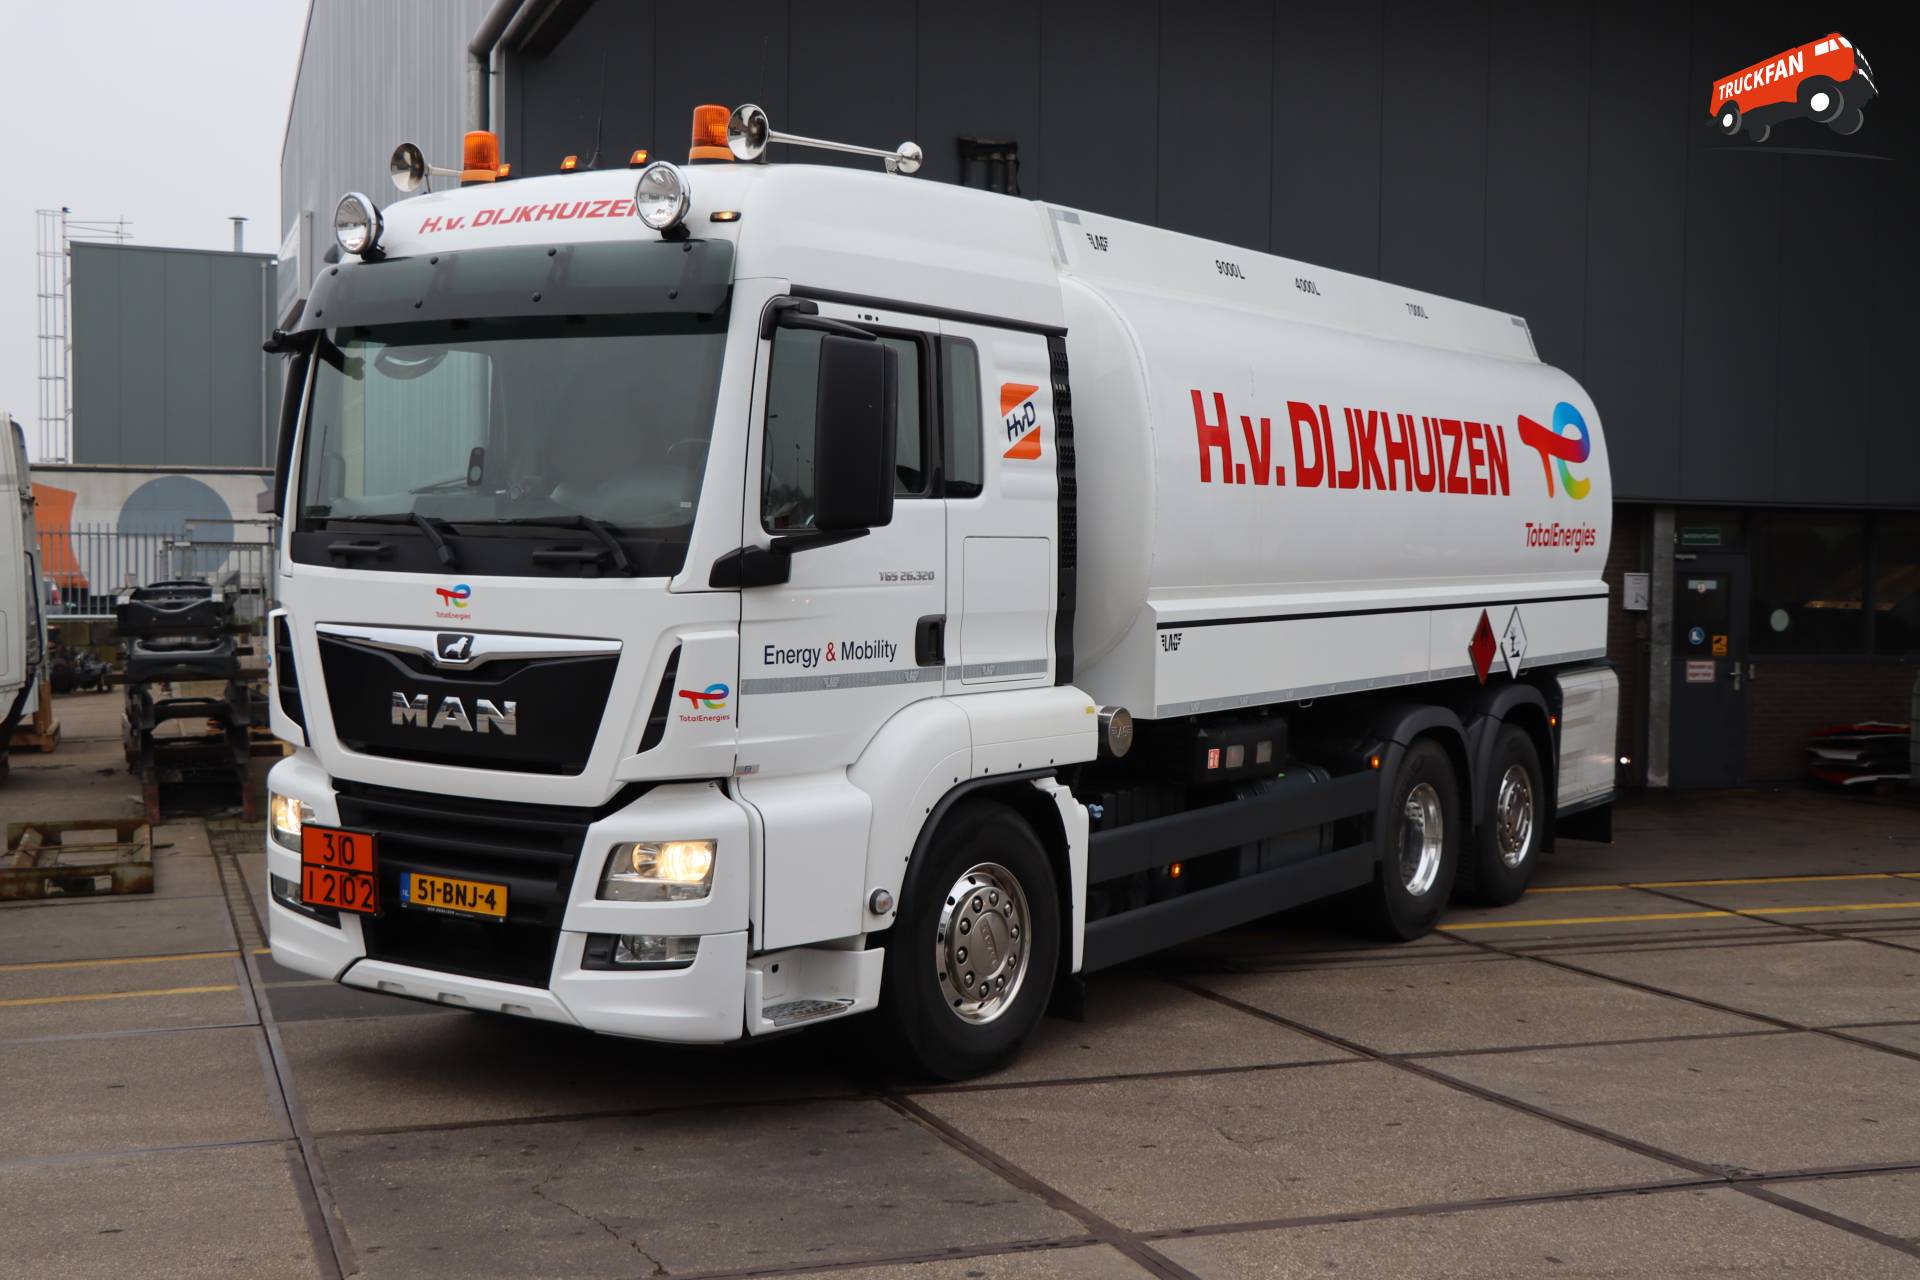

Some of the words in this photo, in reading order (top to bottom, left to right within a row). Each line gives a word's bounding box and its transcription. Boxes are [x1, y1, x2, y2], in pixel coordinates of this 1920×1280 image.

[418, 215, 465, 235] H.v.
[1215, 259, 1246, 280] 9000L
[1295, 277, 1321, 296] 4000L
[1006, 401, 1036, 442] HvD
[1190, 389, 1286, 487] H.v.
[1286, 400, 1510, 497] DIJKHUIZEN
[1525, 522, 1596, 552] TotalEnergies
[763, 644, 821, 667] Energy
[825, 641, 837, 662] &
[841, 639, 898, 663] Mobility
[391, 691, 517, 736] MAN
[679, 714, 730, 722] TotalEnergies
[322, 833, 355, 866] 30
[308, 870, 373, 909] 1202
[417, 878, 497, 910] 51-BNJ-4
